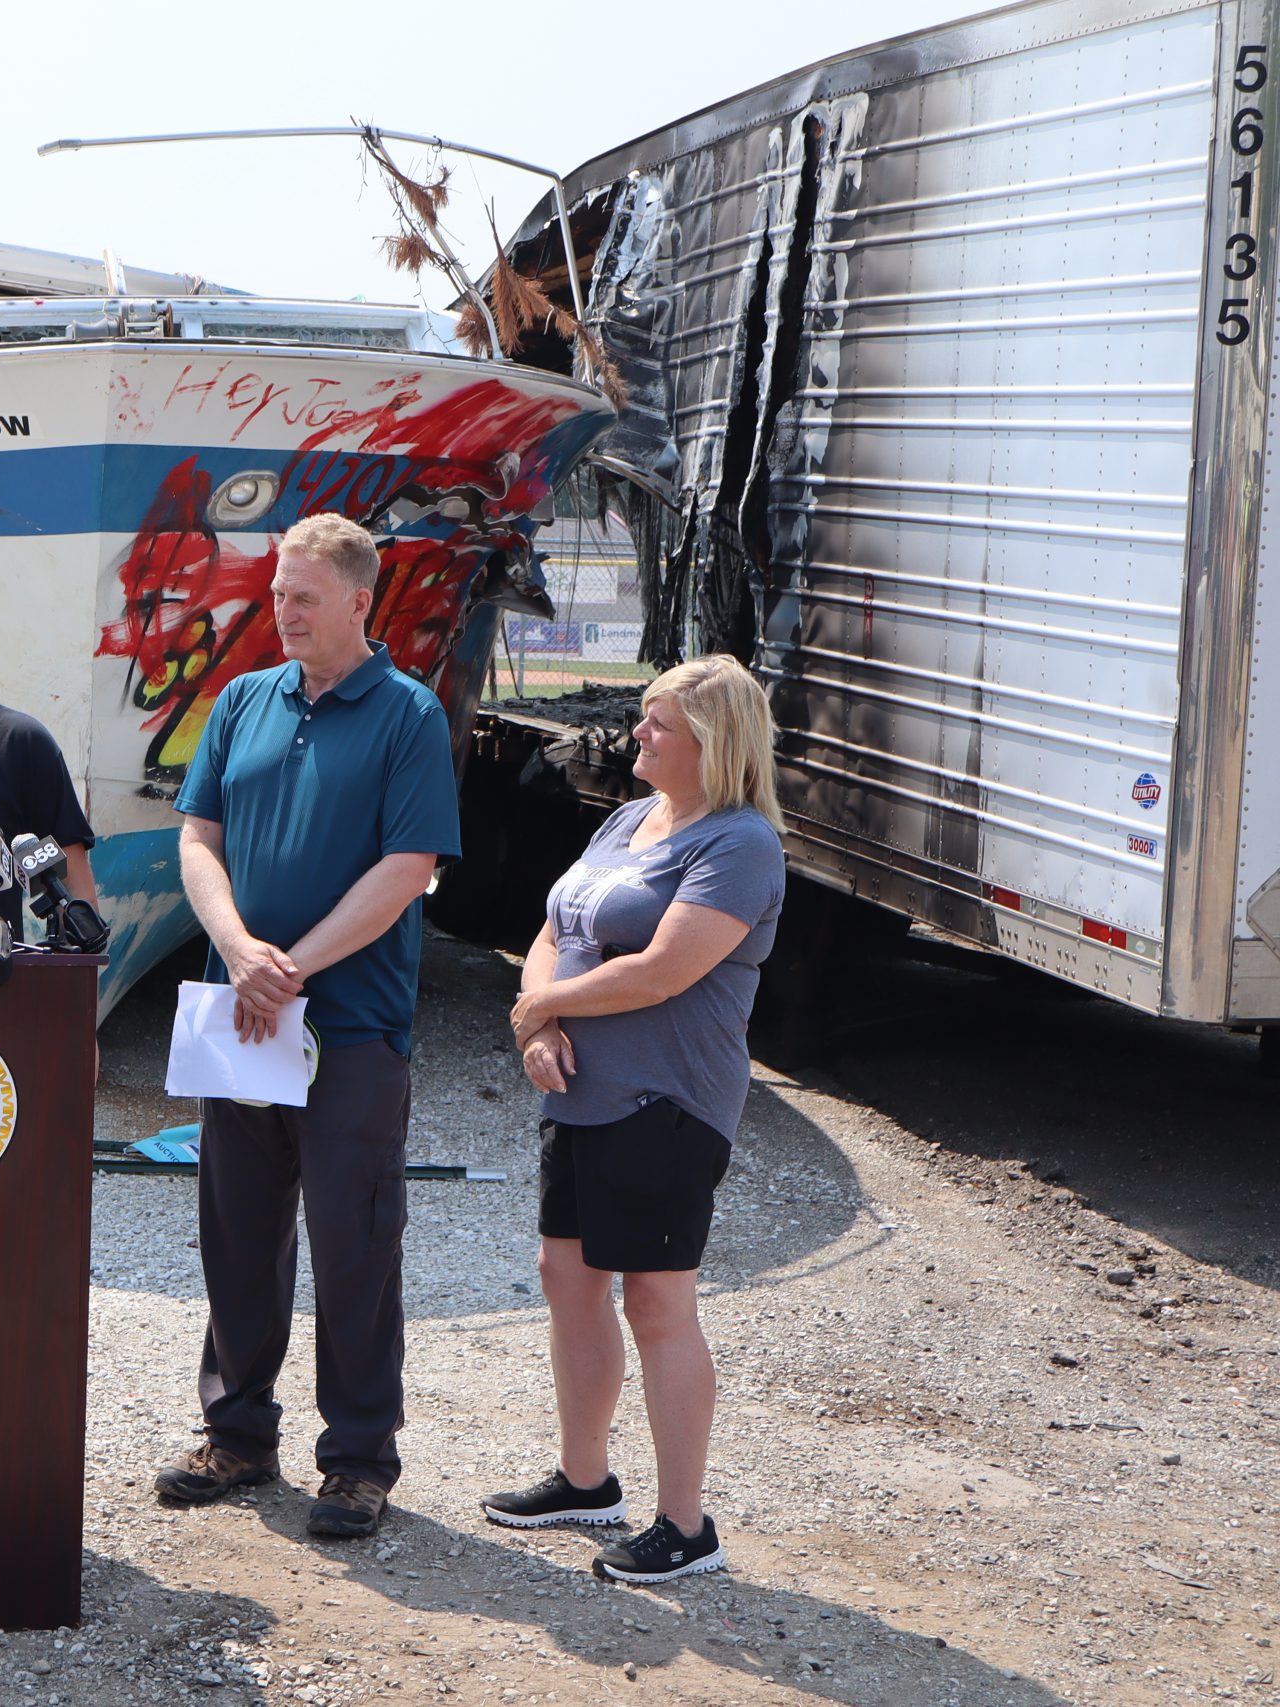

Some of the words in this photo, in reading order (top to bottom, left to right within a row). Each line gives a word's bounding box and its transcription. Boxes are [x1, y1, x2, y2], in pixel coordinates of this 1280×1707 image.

[1215, 44, 1268, 346] 56135
[163, 360, 291, 442] Hey
[601, 628, 642, 639] Landma
[1133, 786, 1159, 799] UTILITY
[33, 843, 59, 864] 58
[1128, 837, 1154, 857] 3000R
[154, 1142, 180, 1162] AUCTIO
